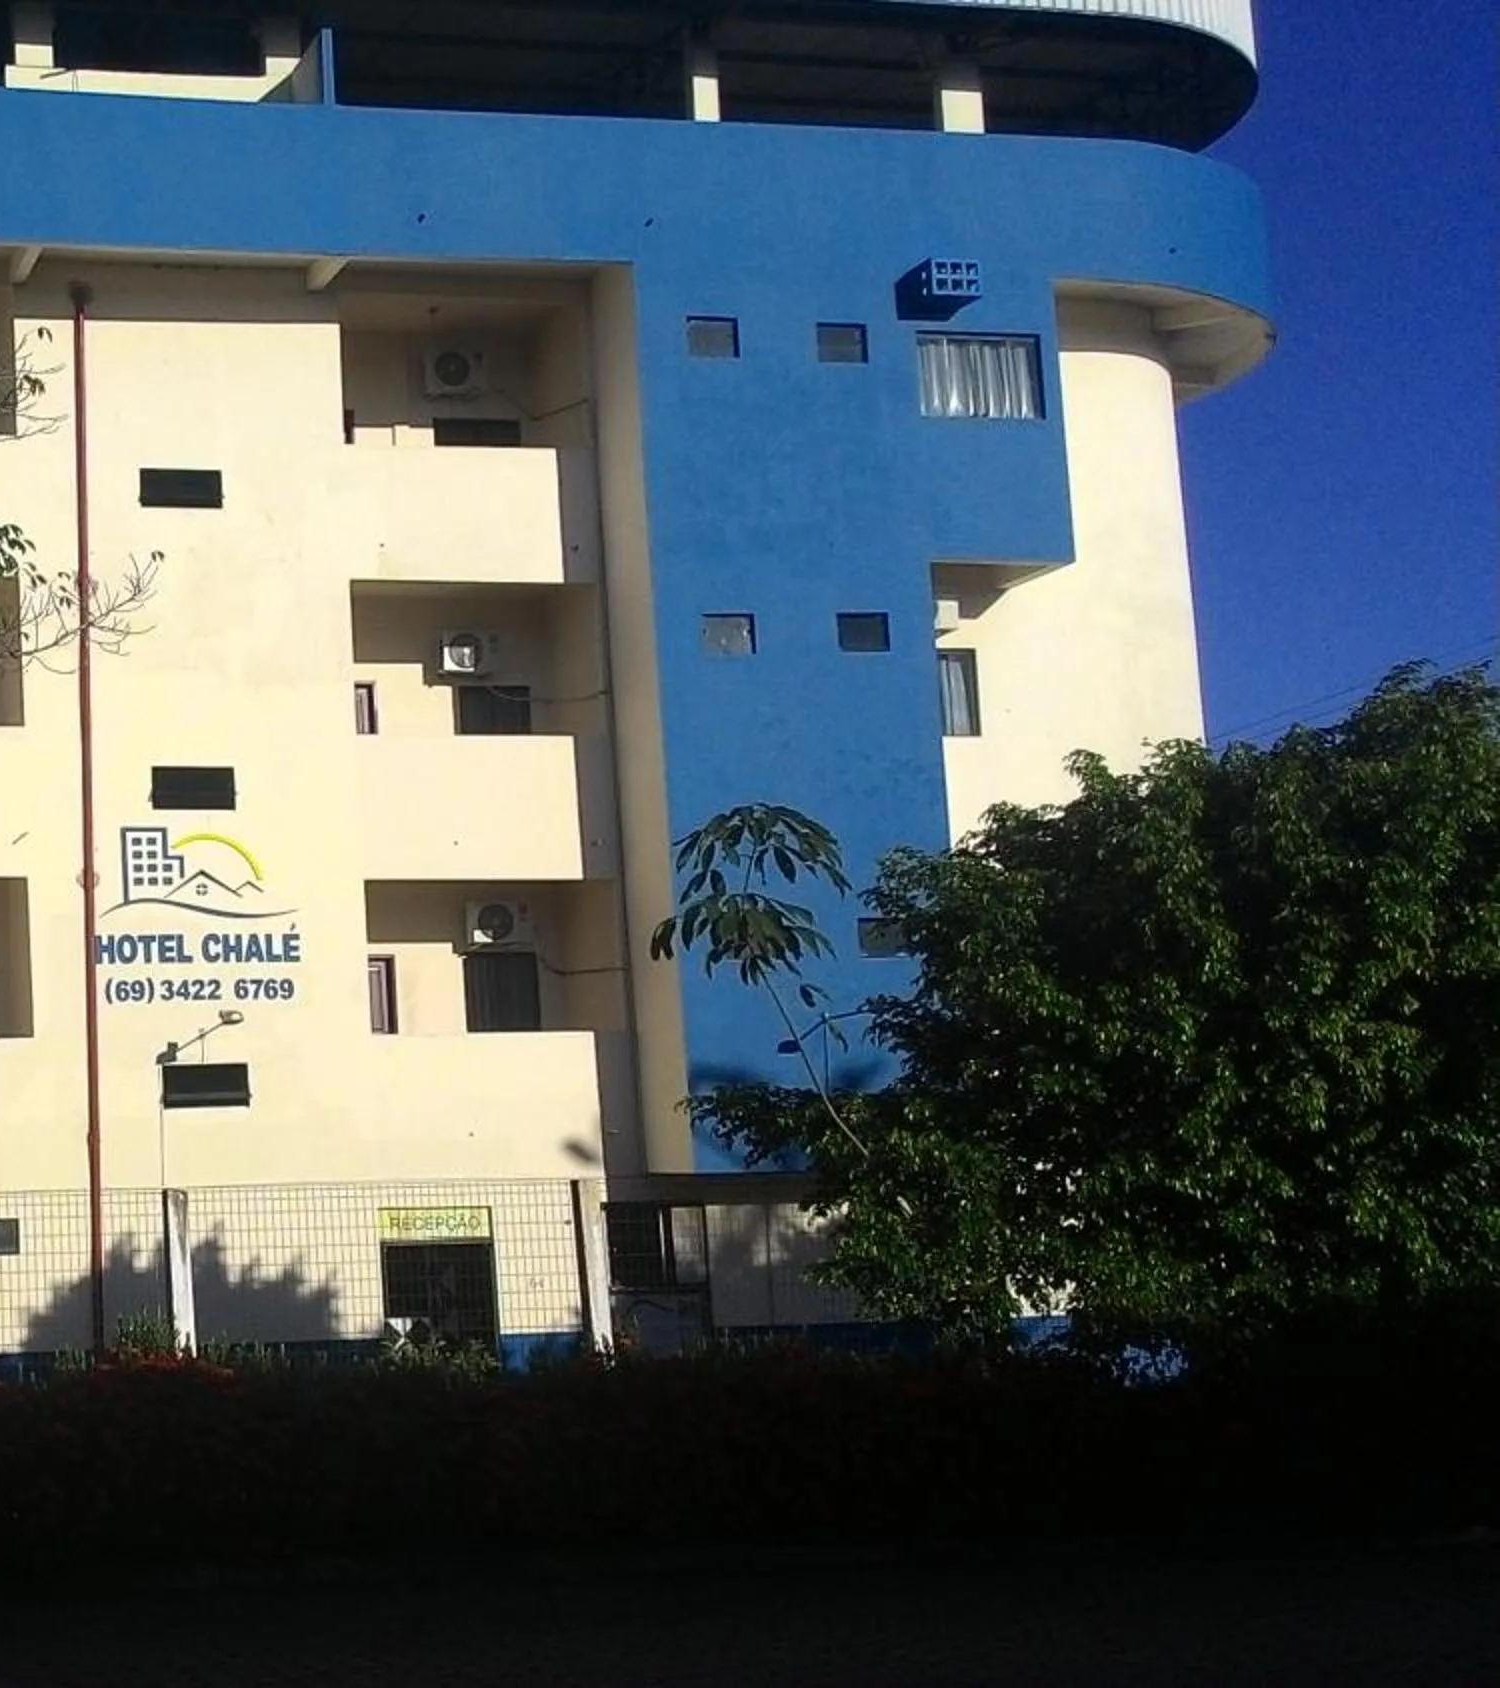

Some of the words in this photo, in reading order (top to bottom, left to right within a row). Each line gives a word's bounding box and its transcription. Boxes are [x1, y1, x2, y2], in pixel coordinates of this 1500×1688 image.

[93, 934, 193, 964] HOTEL
[202, 923, 301, 963] CHALÉ
[104, 977, 155, 1004] (69)
[160, 979, 222, 1001] 3422
[233, 978, 295, 1000] 6769
[389, 1212, 481, 1232] RECEPÇÃO
